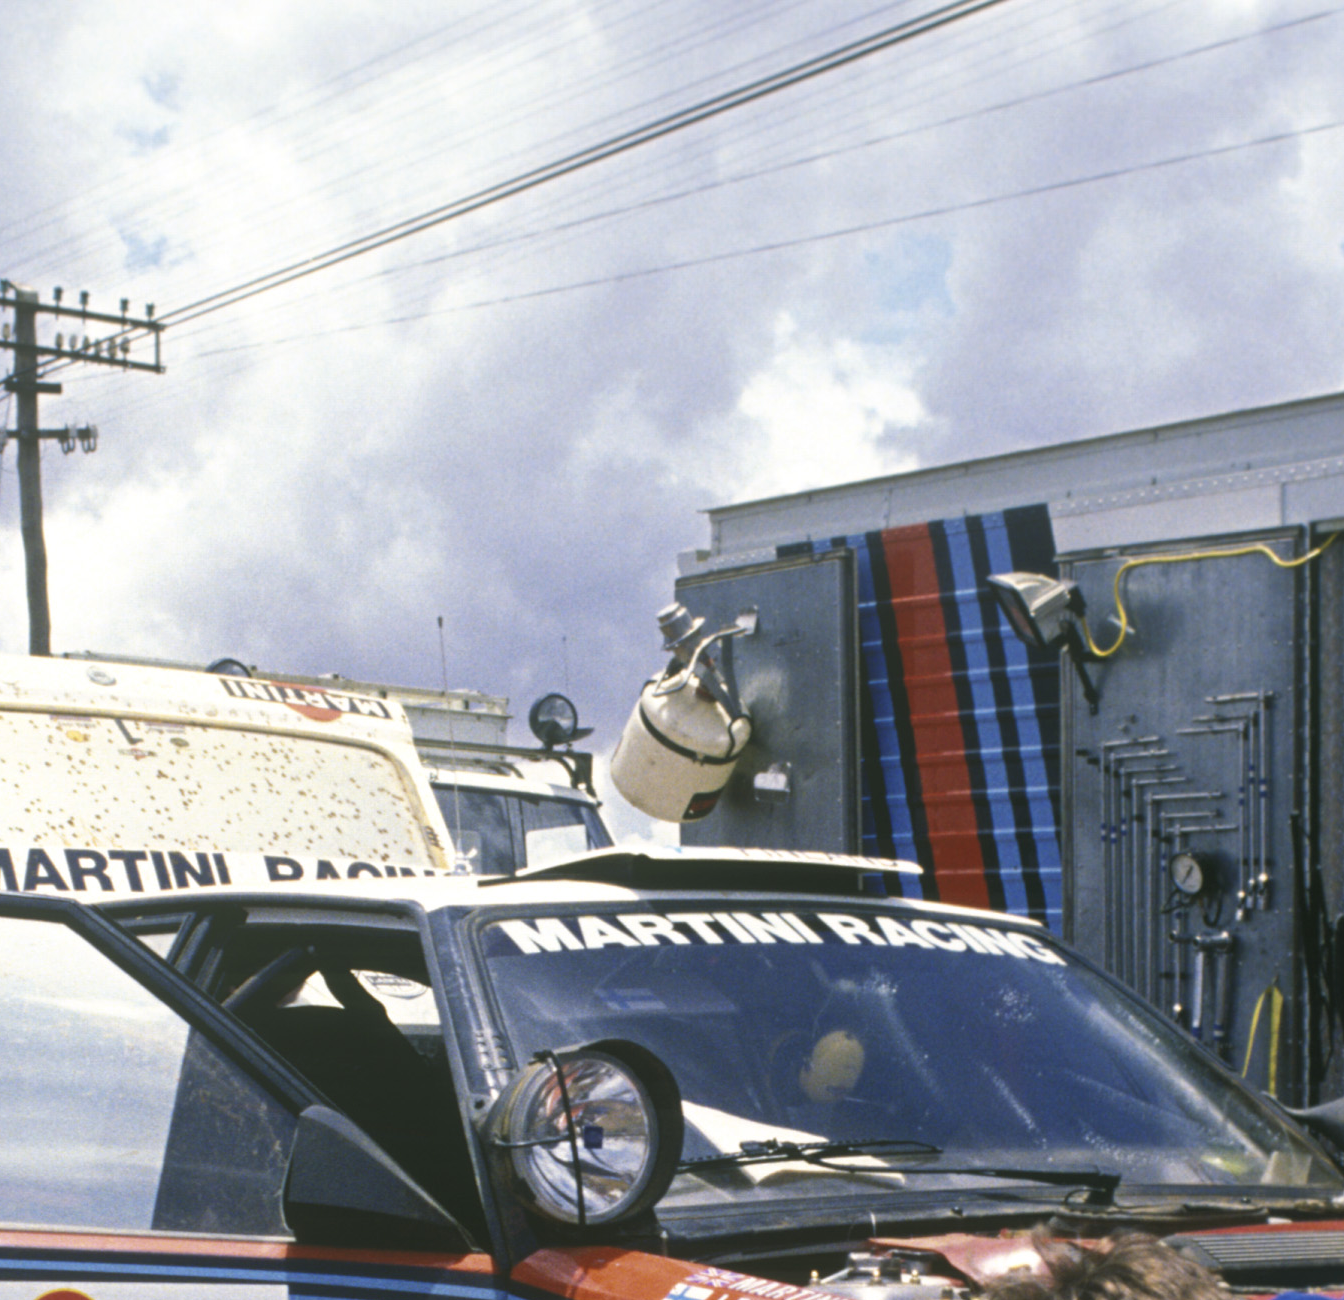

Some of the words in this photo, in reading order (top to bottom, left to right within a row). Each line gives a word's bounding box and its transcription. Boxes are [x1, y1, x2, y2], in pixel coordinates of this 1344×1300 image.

[224, 679, 389, 719] MARTINI
[499, 911, 824, 955] MARTINI
[819, 912, 1068, 966] RACING
